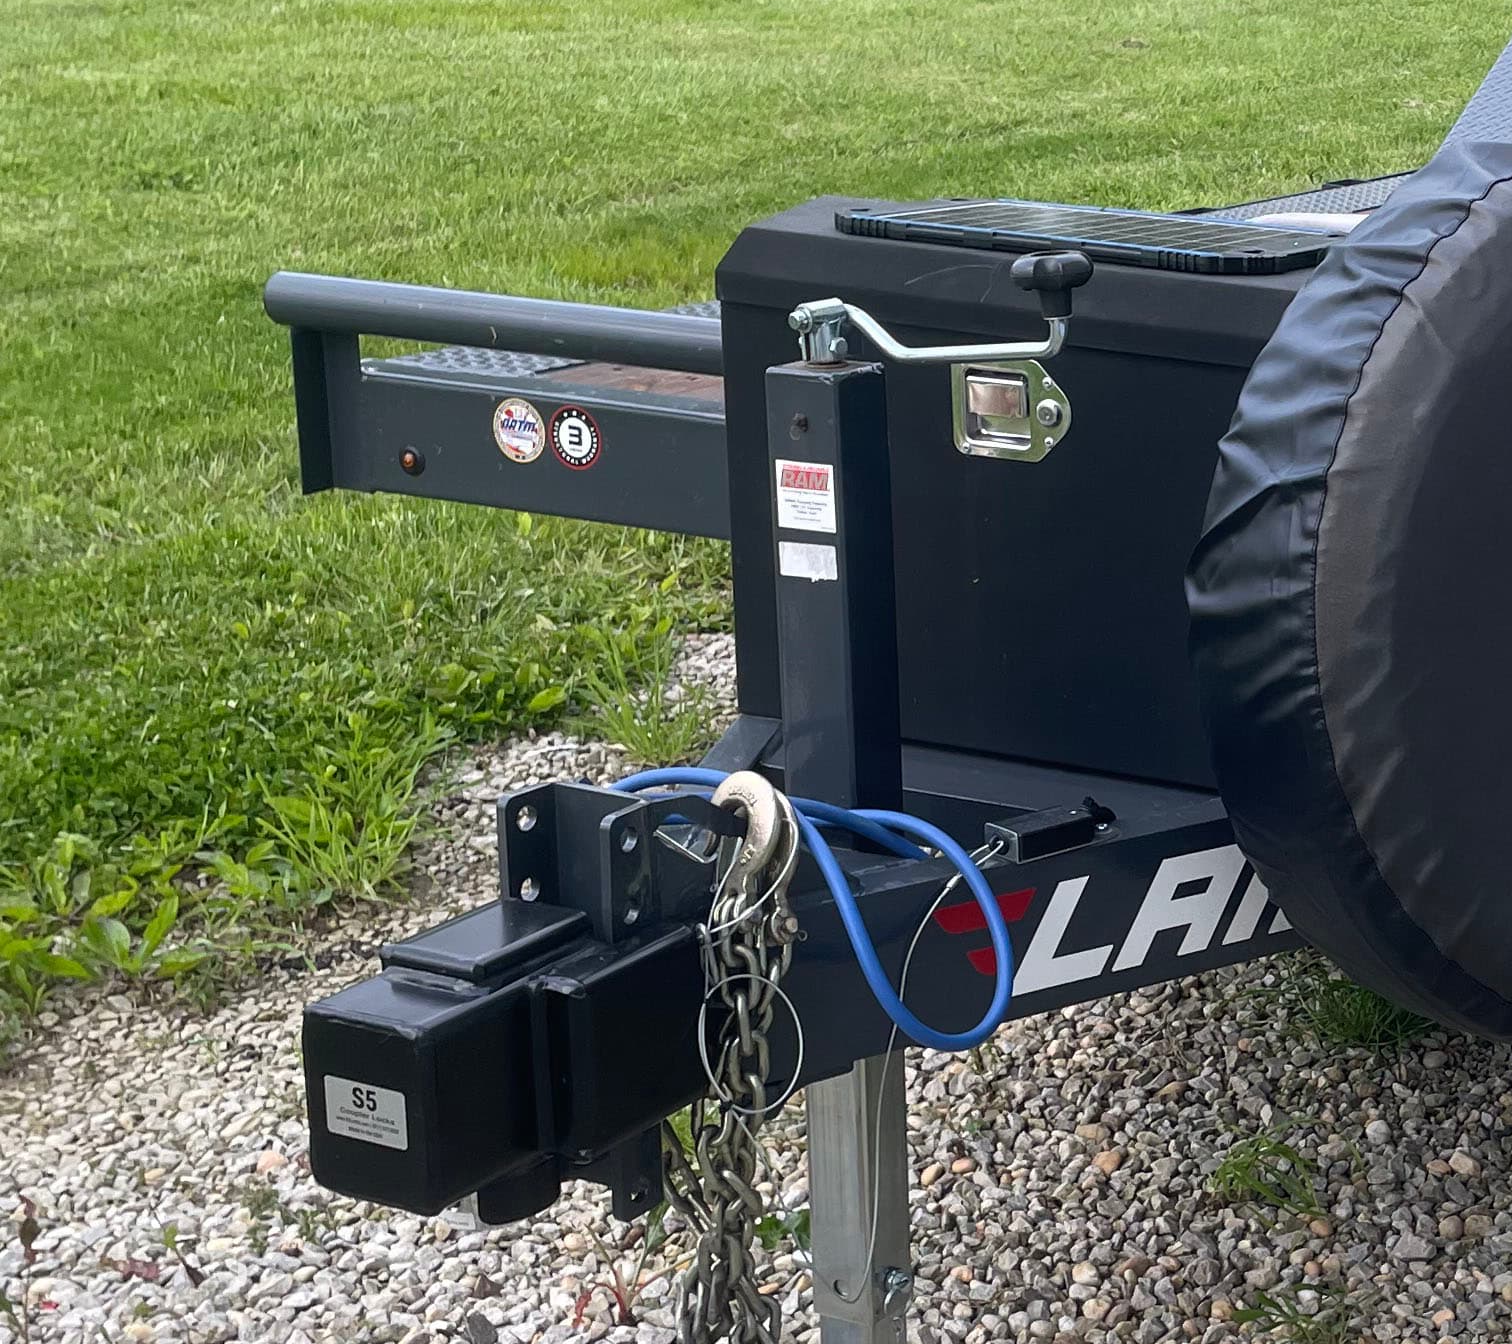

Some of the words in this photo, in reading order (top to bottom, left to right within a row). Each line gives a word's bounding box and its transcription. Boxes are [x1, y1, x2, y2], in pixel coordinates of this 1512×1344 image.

[568, 424, 583, 447] 3
[780, 468, 829, 492] RAM
[352, 1087, 377, 1112] S5
